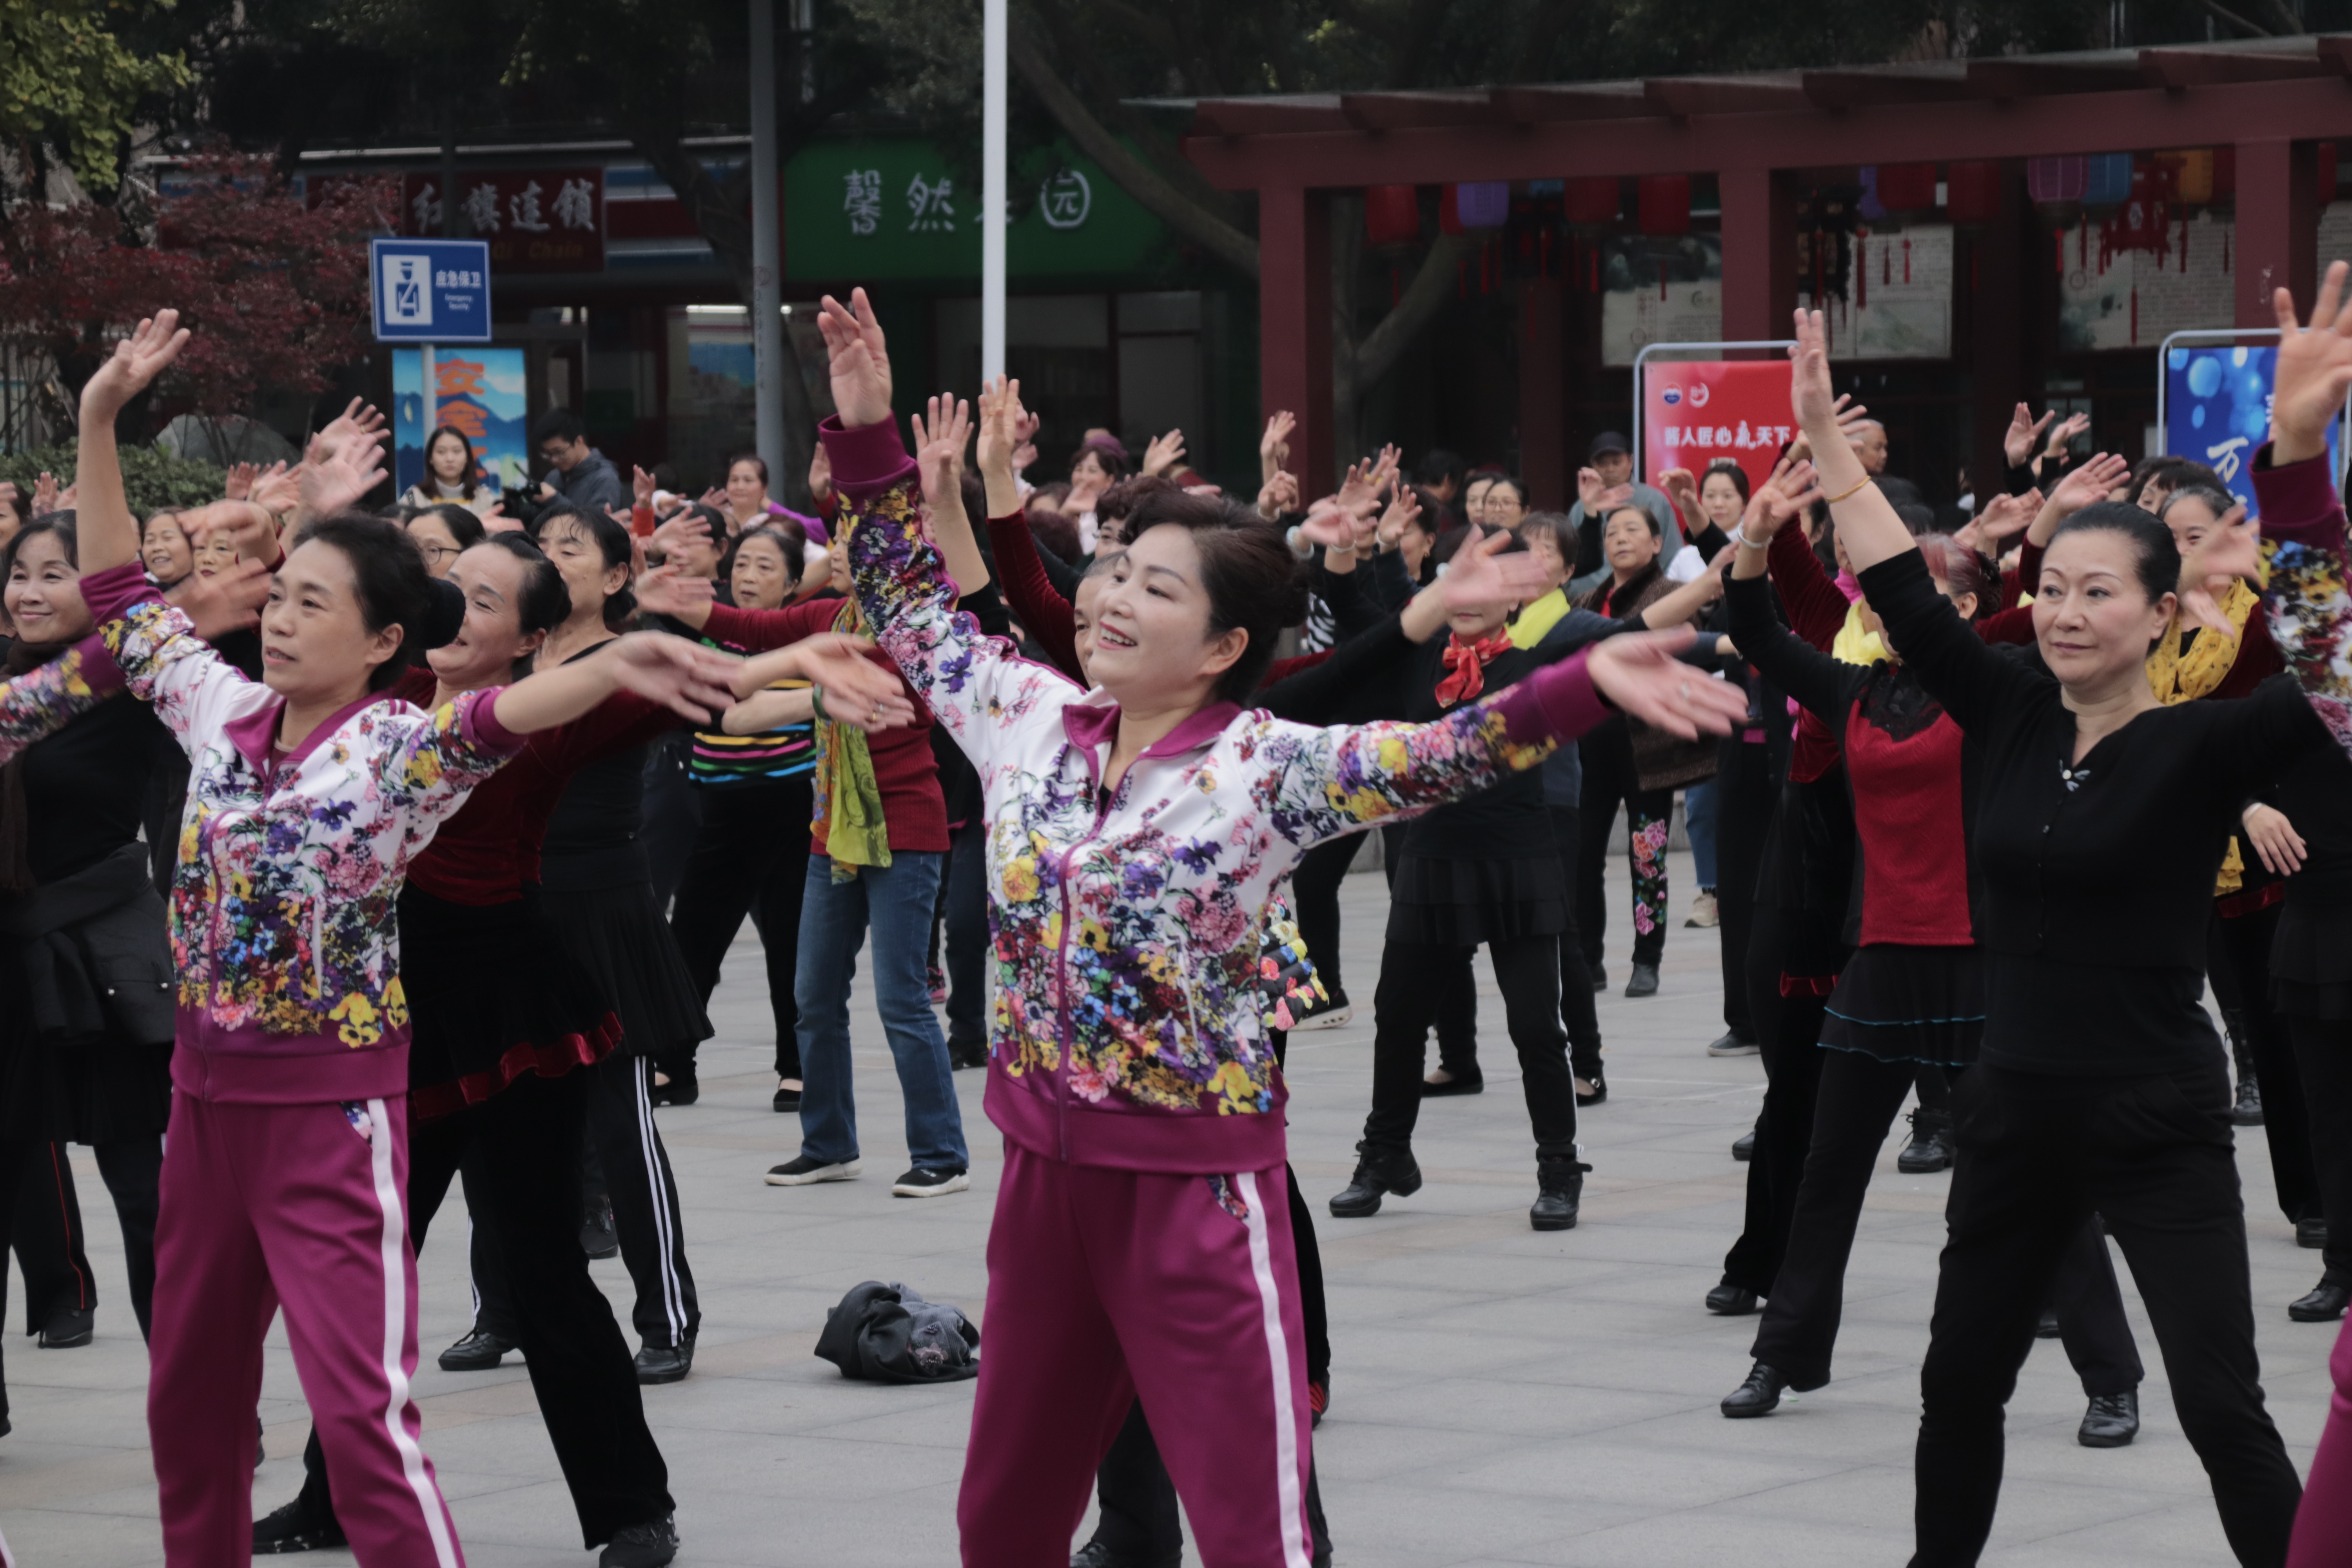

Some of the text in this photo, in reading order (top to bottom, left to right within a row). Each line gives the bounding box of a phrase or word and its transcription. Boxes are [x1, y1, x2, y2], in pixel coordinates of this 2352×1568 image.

[843, 170, 1091, 235] 馨然园
[436, 270, 482, 288] 应急保卫
